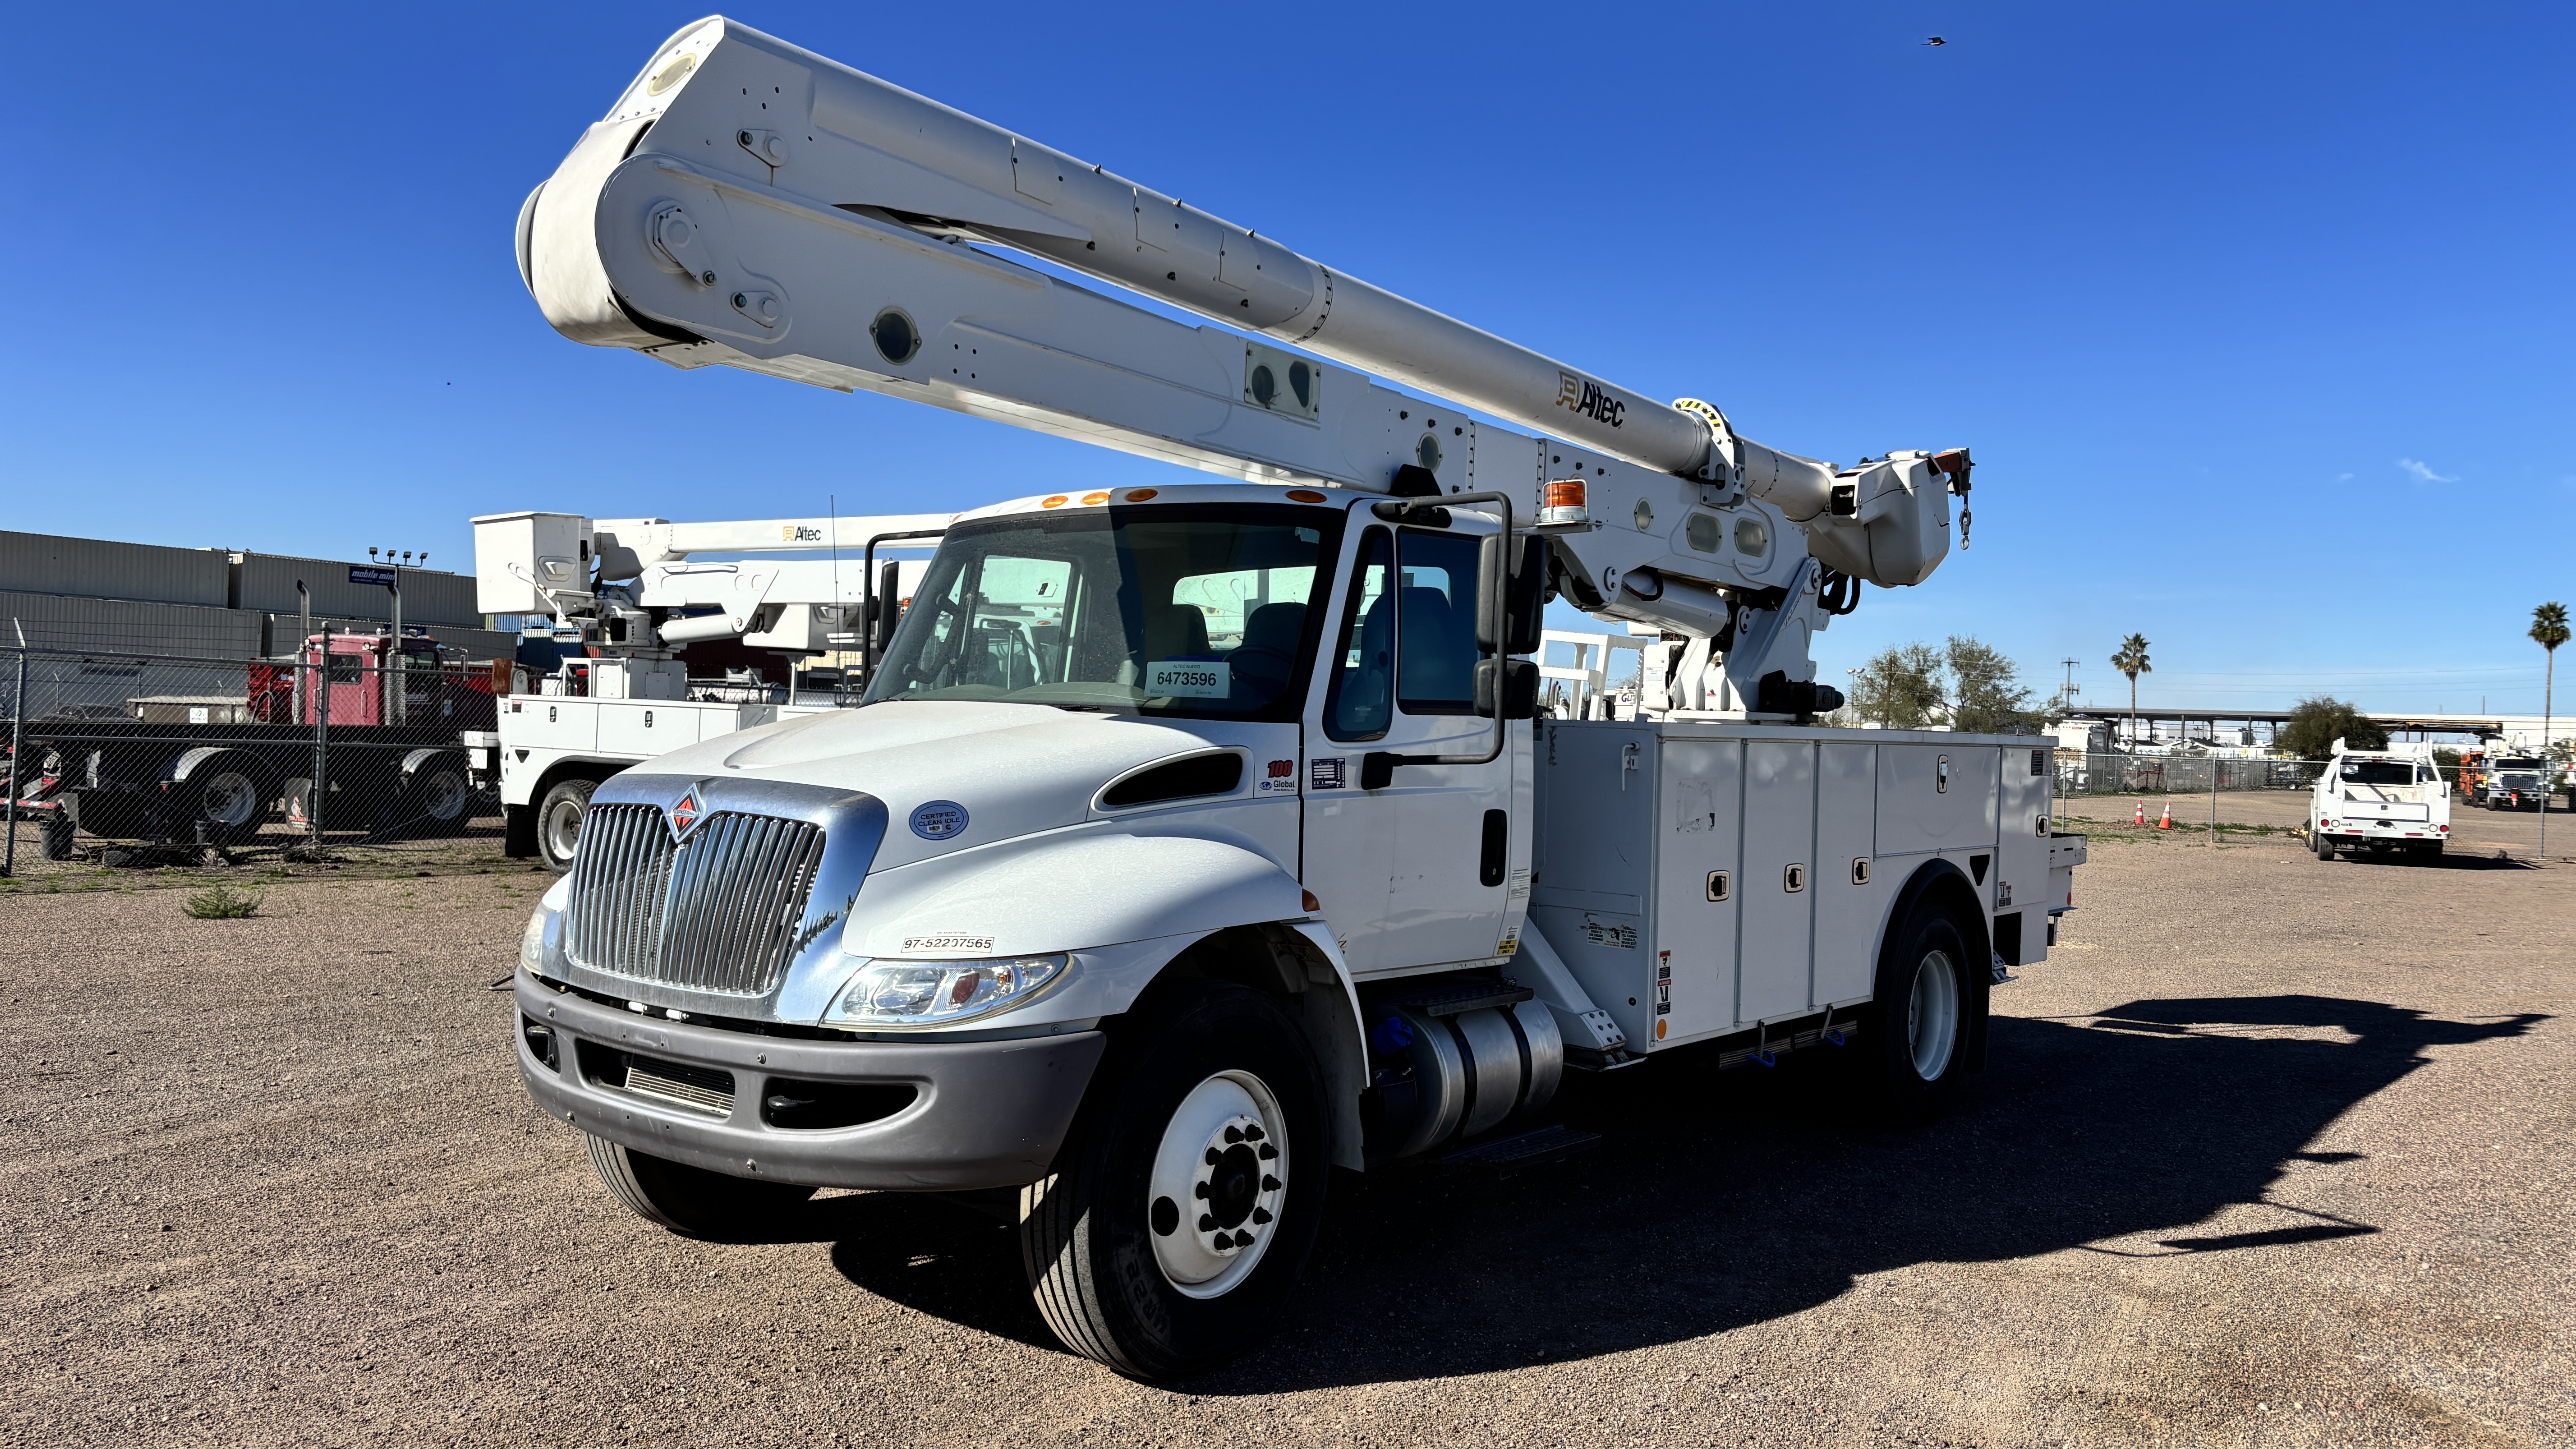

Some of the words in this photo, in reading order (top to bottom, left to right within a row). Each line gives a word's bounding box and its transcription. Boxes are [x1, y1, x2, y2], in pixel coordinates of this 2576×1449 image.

[1575, 381, 1625, 428] Altec
[794, 526, 821, 541] Altec
[351, 569, 378, 579] mobile
[1157, 672, 1216, 686] 6473596
[1267, 759, 1293, 778] 108
[920, 811, 956, 820] CERTIFIED
